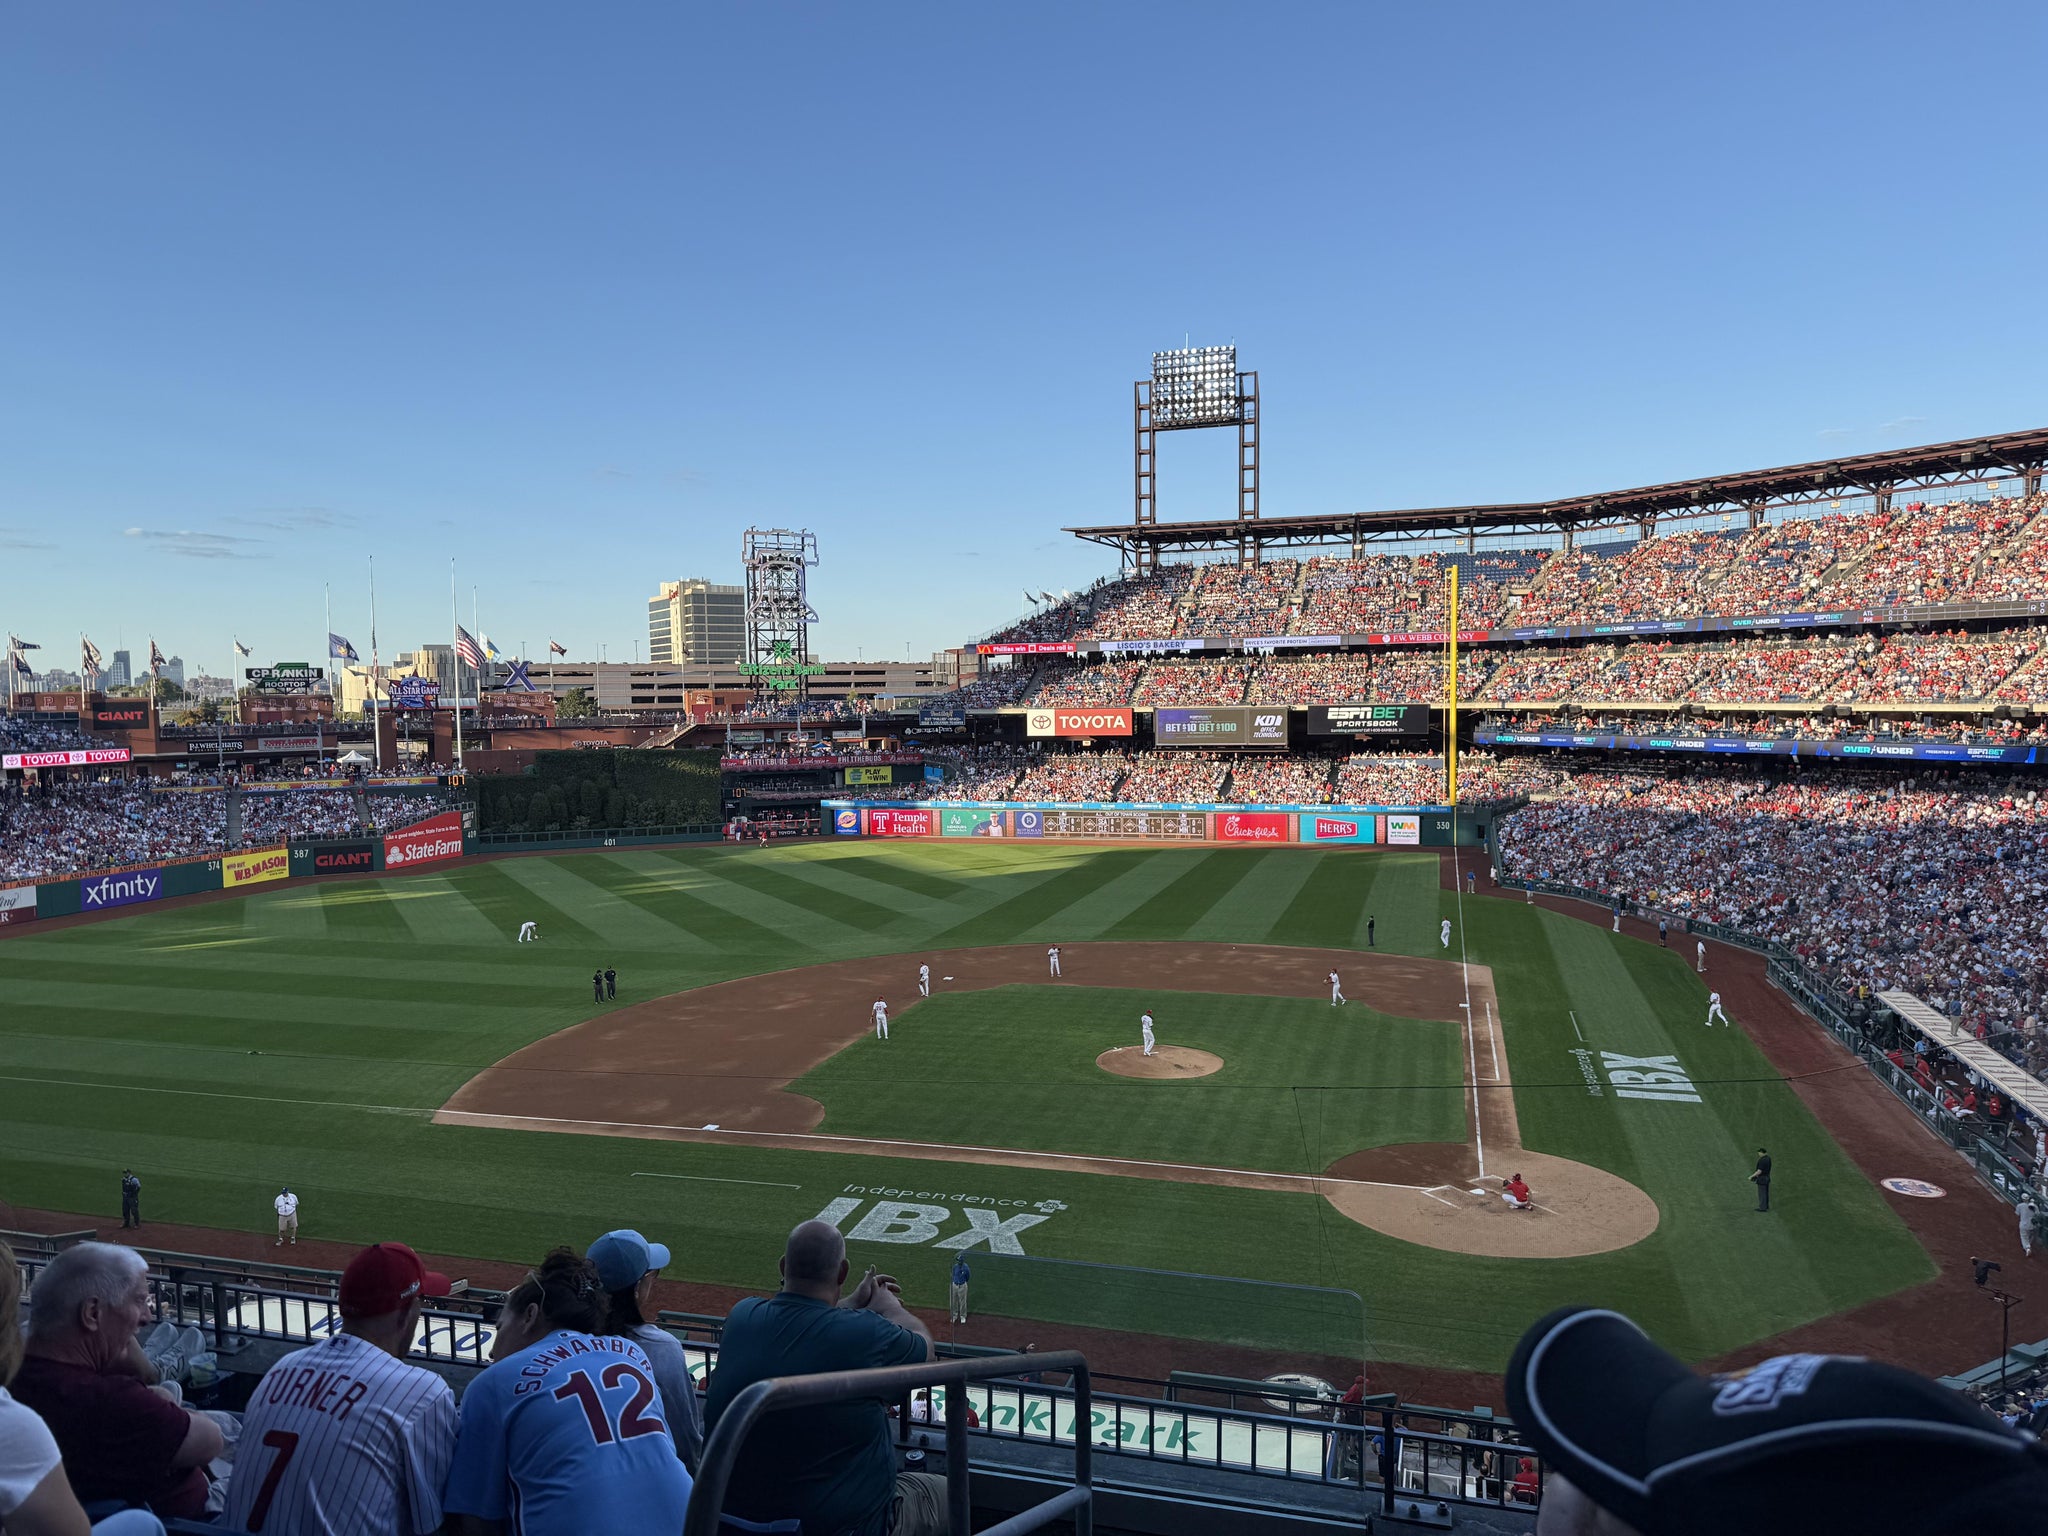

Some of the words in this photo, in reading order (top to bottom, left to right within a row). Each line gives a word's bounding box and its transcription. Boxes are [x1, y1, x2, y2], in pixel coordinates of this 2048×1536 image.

[1408, 634, 1432, 642] WEBB
[1433, 632, 1475, 641] COMANY
[271, 668, 318, 678] RANKIN
[740, 663, 792, 676] Citizens
[794, 663, 826, 676] Bank
[388, 686, 402, 695] ALL
[402, 685, 420, 695] STAR
[420, 685, 441, 695] GAME
[769, 678, 798, 690] Park
[97, 711, 144, 721] GIANT
[1327, 707, 1372, 720] ESPN
[1372, 706, 1408, 719] BET
[1060, 715, 1126, 729] TOYOTA
[1254, 715, 1283, 727] KDI
[1336, 720, 1399, 728] SPORTSBOOK
[1165, 724, 1182, 732] BET
[1182, 724, 1196, 732] $10
[1199, 723, 1215, 732] GET
[1216, 723, 1237, 732] $100
[1496, 735, 1540, 743] OVER/UNDER
[1650, 738, 1704, 749] OVER/UNDER
[1843, 744, 1914, 756] OVER/UNDER
[1988, 748, 2005, 756] BET
[25, 754, 66, 765] TOYOTA
[90, 750, 128, 761] TOYOTA
[892, 812, 928, 824] Temple
[892, 824, 926, 834] Health
[1319, 822, 1353, 834] HERR'S
[1391, 822, 1416, 830] WM
[1436, 822, 1450, 830] 330
[294, 850, 308, 858] 387
[316, 852, 372, 867] GIANT
[118, 862, 158, 873] ASPLUNDH
[208, 861, 220, 871] 374
[70, 868, 112, 880] ASPLUNDH
[16, 875, 62, 887] ASPLUNDH
[86, 874, 158, 905] xfinity
[1600, 1050, 1702, 1102] IBX
[842, 1184, 1028, 1208] Independence
[814, 1196, 1050, 1256] IBX
[514, 1338, 652, 1395] SCHWARBER
[258, 1366, 368, 1421] TURNER
[552, 1362, 667, 1446] 12
[246, 1430, 299, 1533] 7
